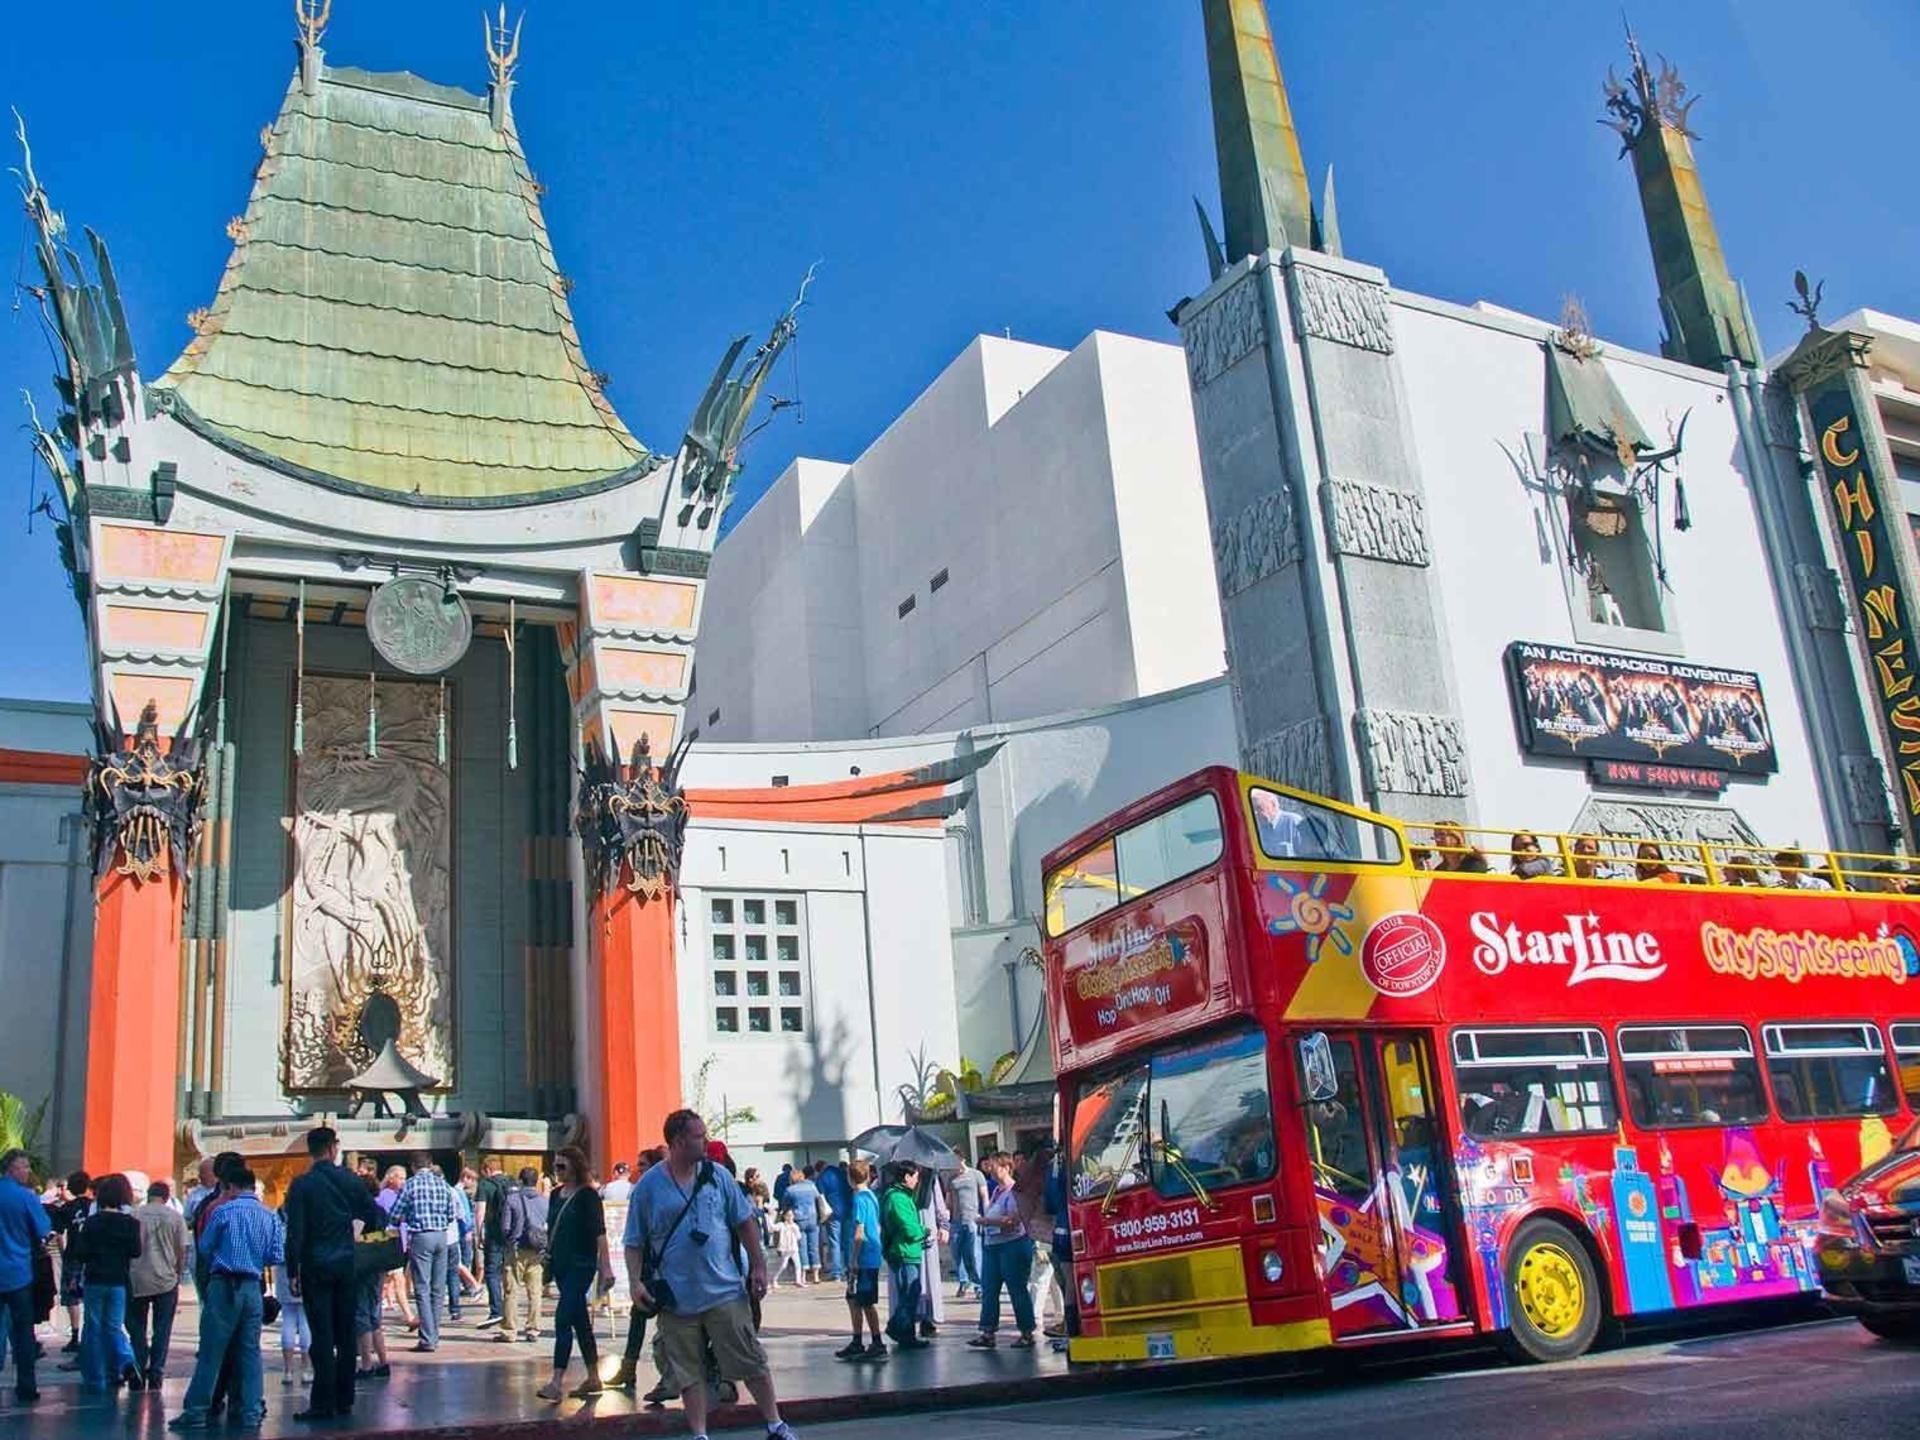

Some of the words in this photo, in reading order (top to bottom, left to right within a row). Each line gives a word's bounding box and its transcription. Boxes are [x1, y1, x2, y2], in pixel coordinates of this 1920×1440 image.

[1550, 648, 1669, 675] ACTION-PACKED
[1646, 767, 1721, 788] SHOWING
[1376, 934, 1428, 970] OFFICIAL
[1470, 911, 1668, 987] StarLine
[1097, 1009, 1118, 1026] Hop
[1113, 1207, 1200, 1239] 1-800-959-3131
